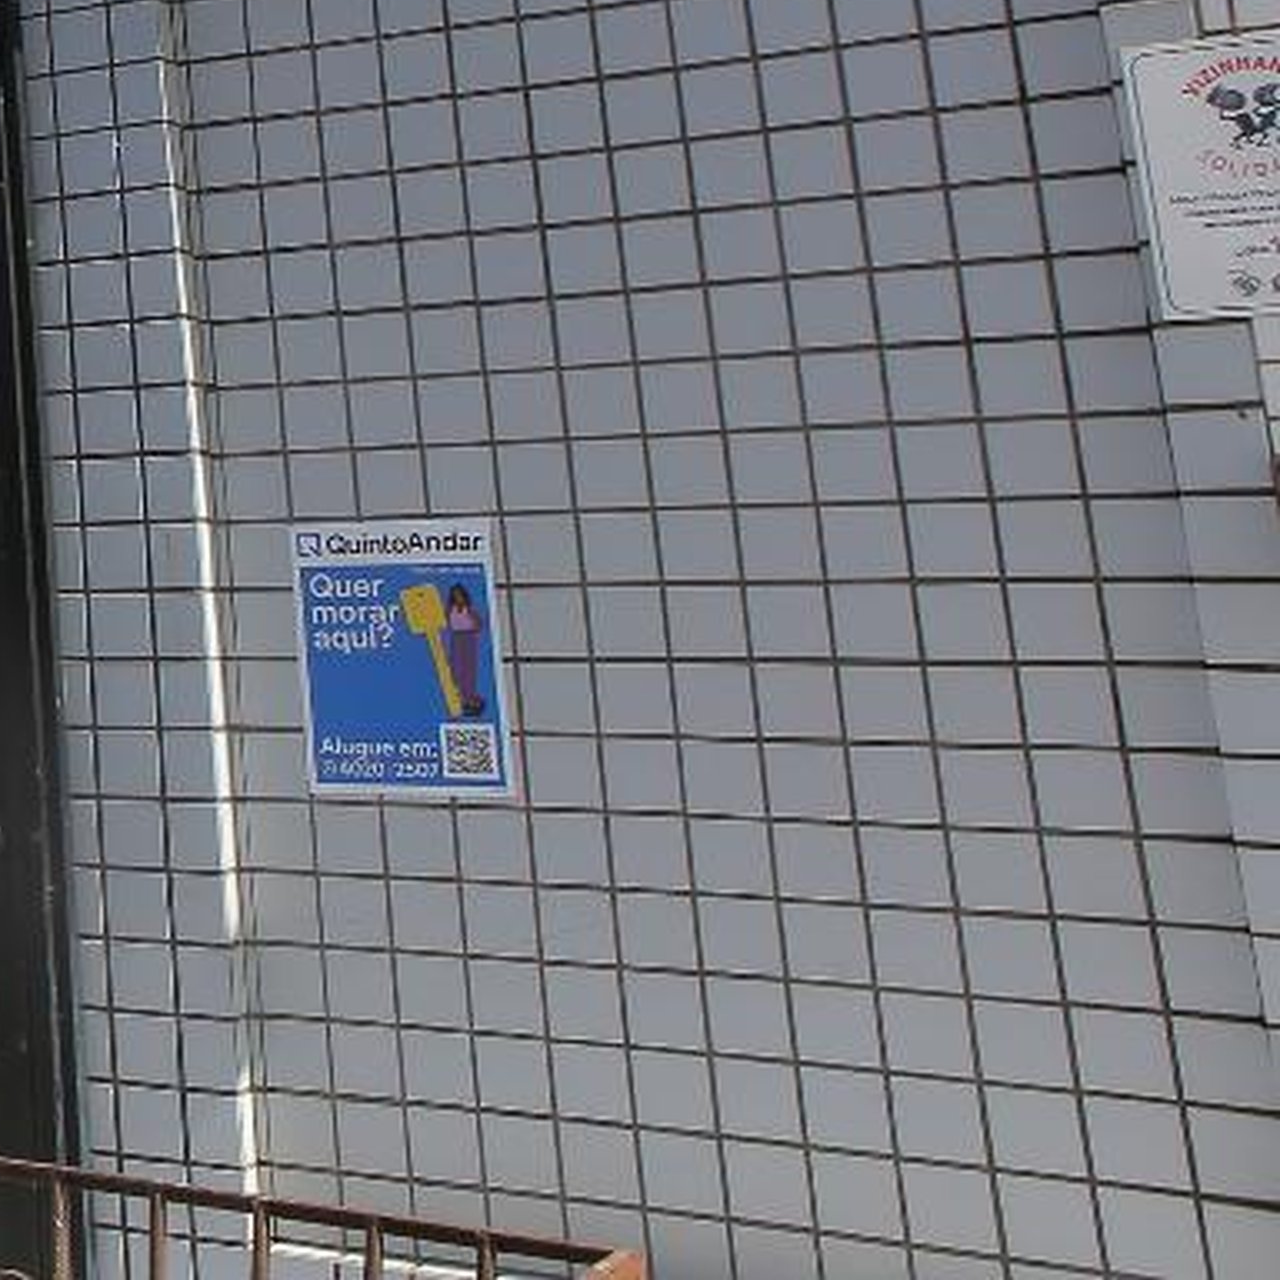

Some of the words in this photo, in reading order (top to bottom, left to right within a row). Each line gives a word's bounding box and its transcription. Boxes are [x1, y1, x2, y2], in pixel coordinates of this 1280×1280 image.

[325, 532, 483, 556] QuintoAndar
[308, 573, 384, 600] Quer
[311, 601, 400, 624] morar
[314, 623, 394, 653] aqui?
[319, 736, 394, 759] Alugue
[399, 741, 439, 758] em:
